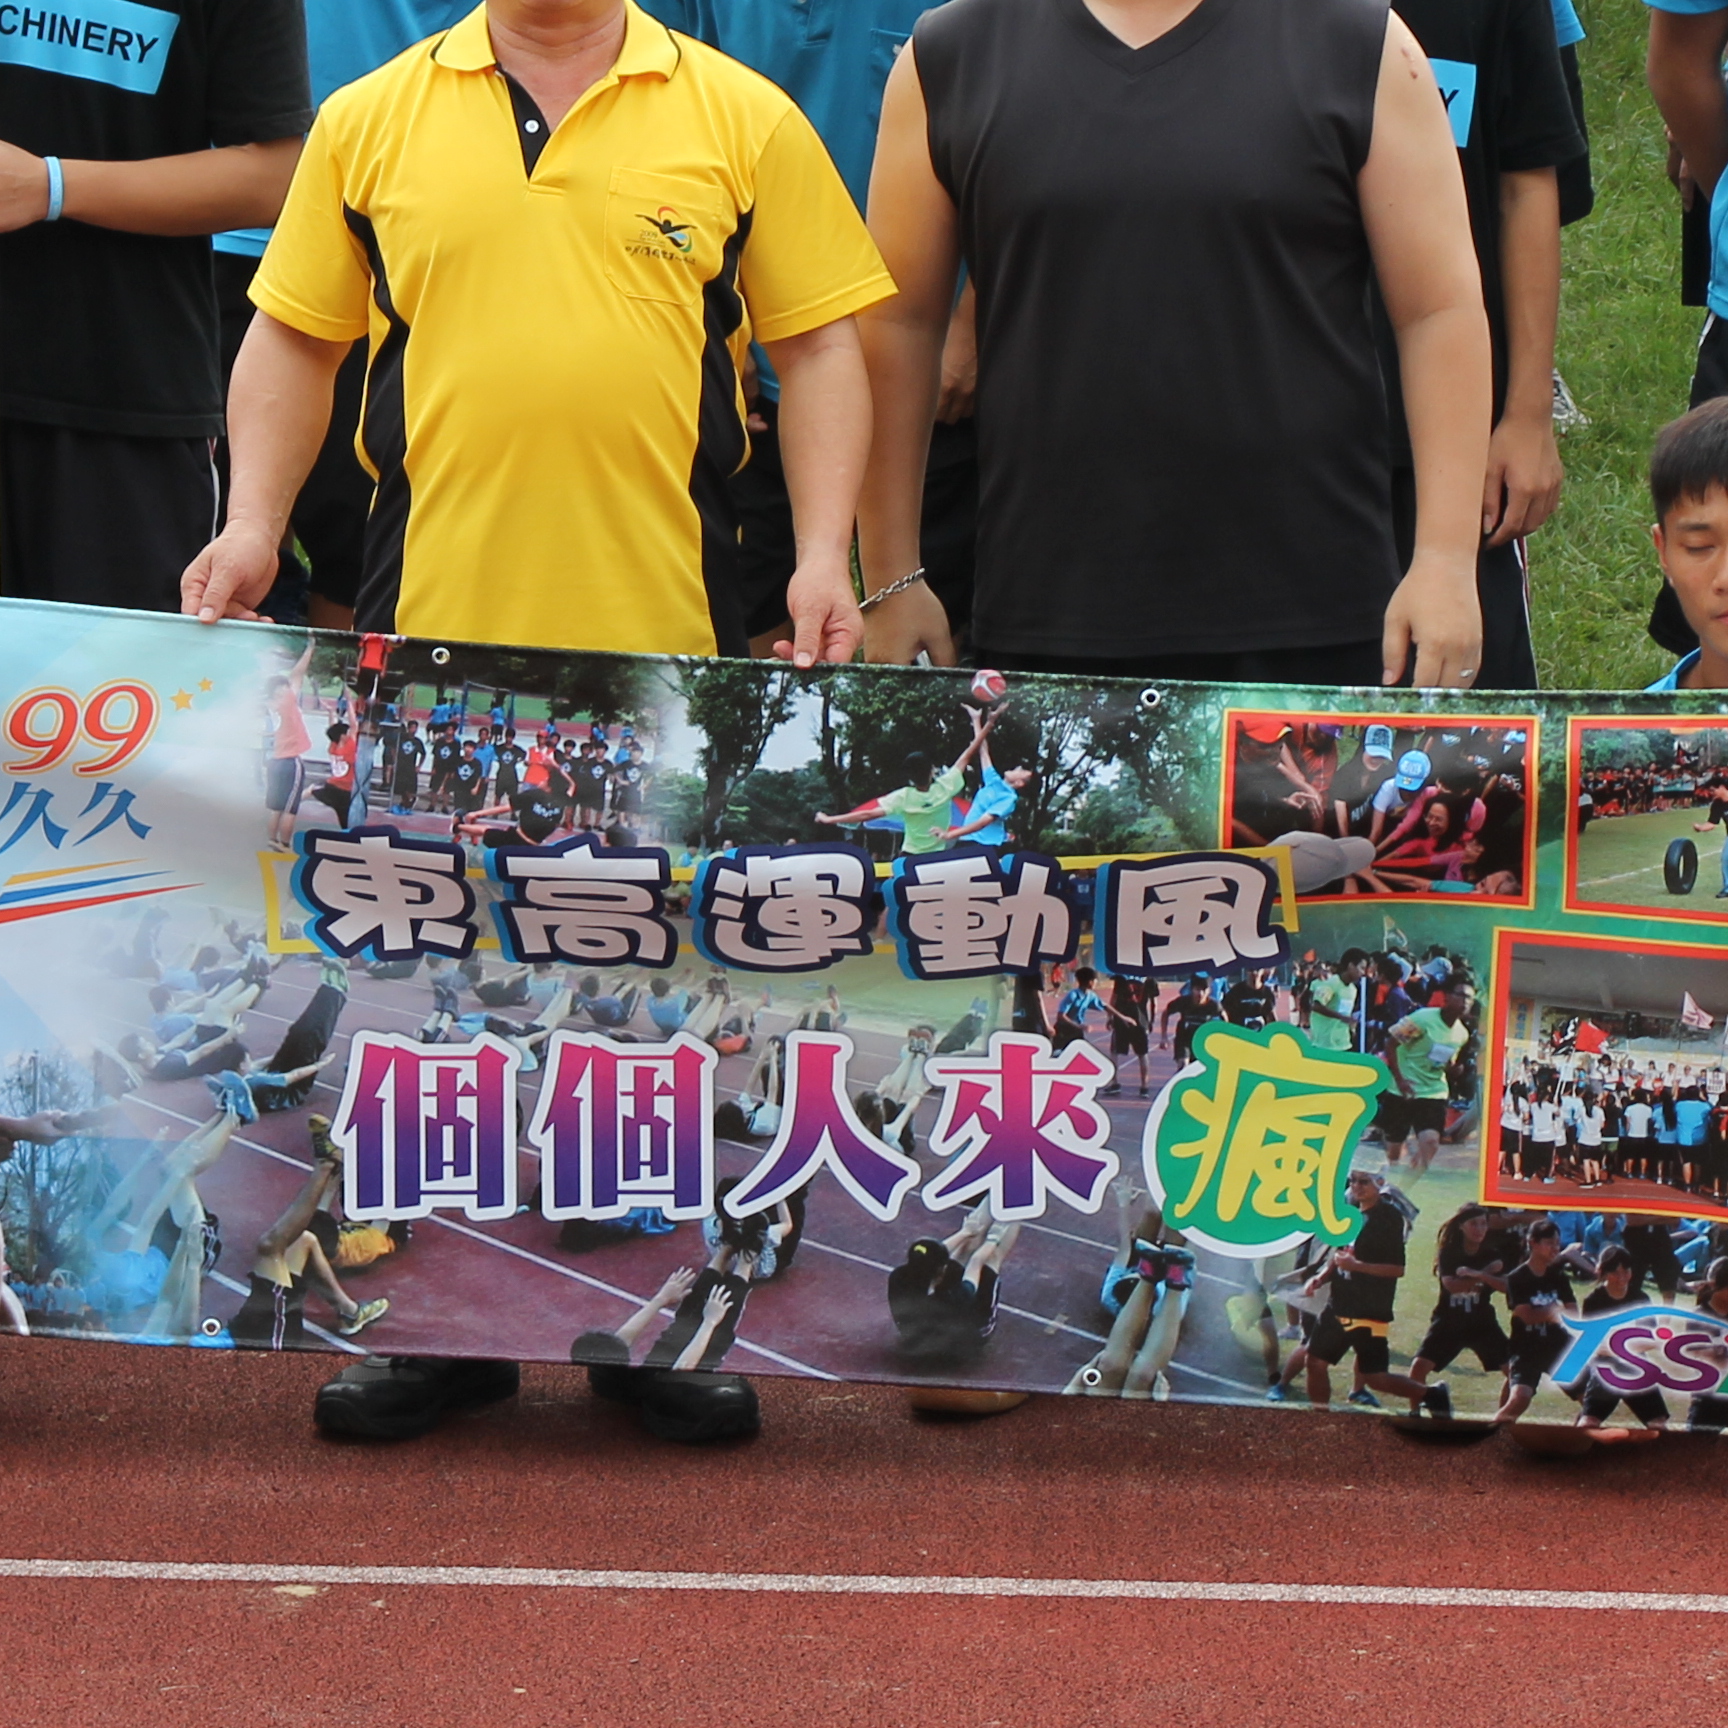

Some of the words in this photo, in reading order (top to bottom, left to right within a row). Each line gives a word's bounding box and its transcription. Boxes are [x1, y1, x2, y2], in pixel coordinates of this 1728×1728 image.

[302, 830, 1286, 976] 東高運動風
